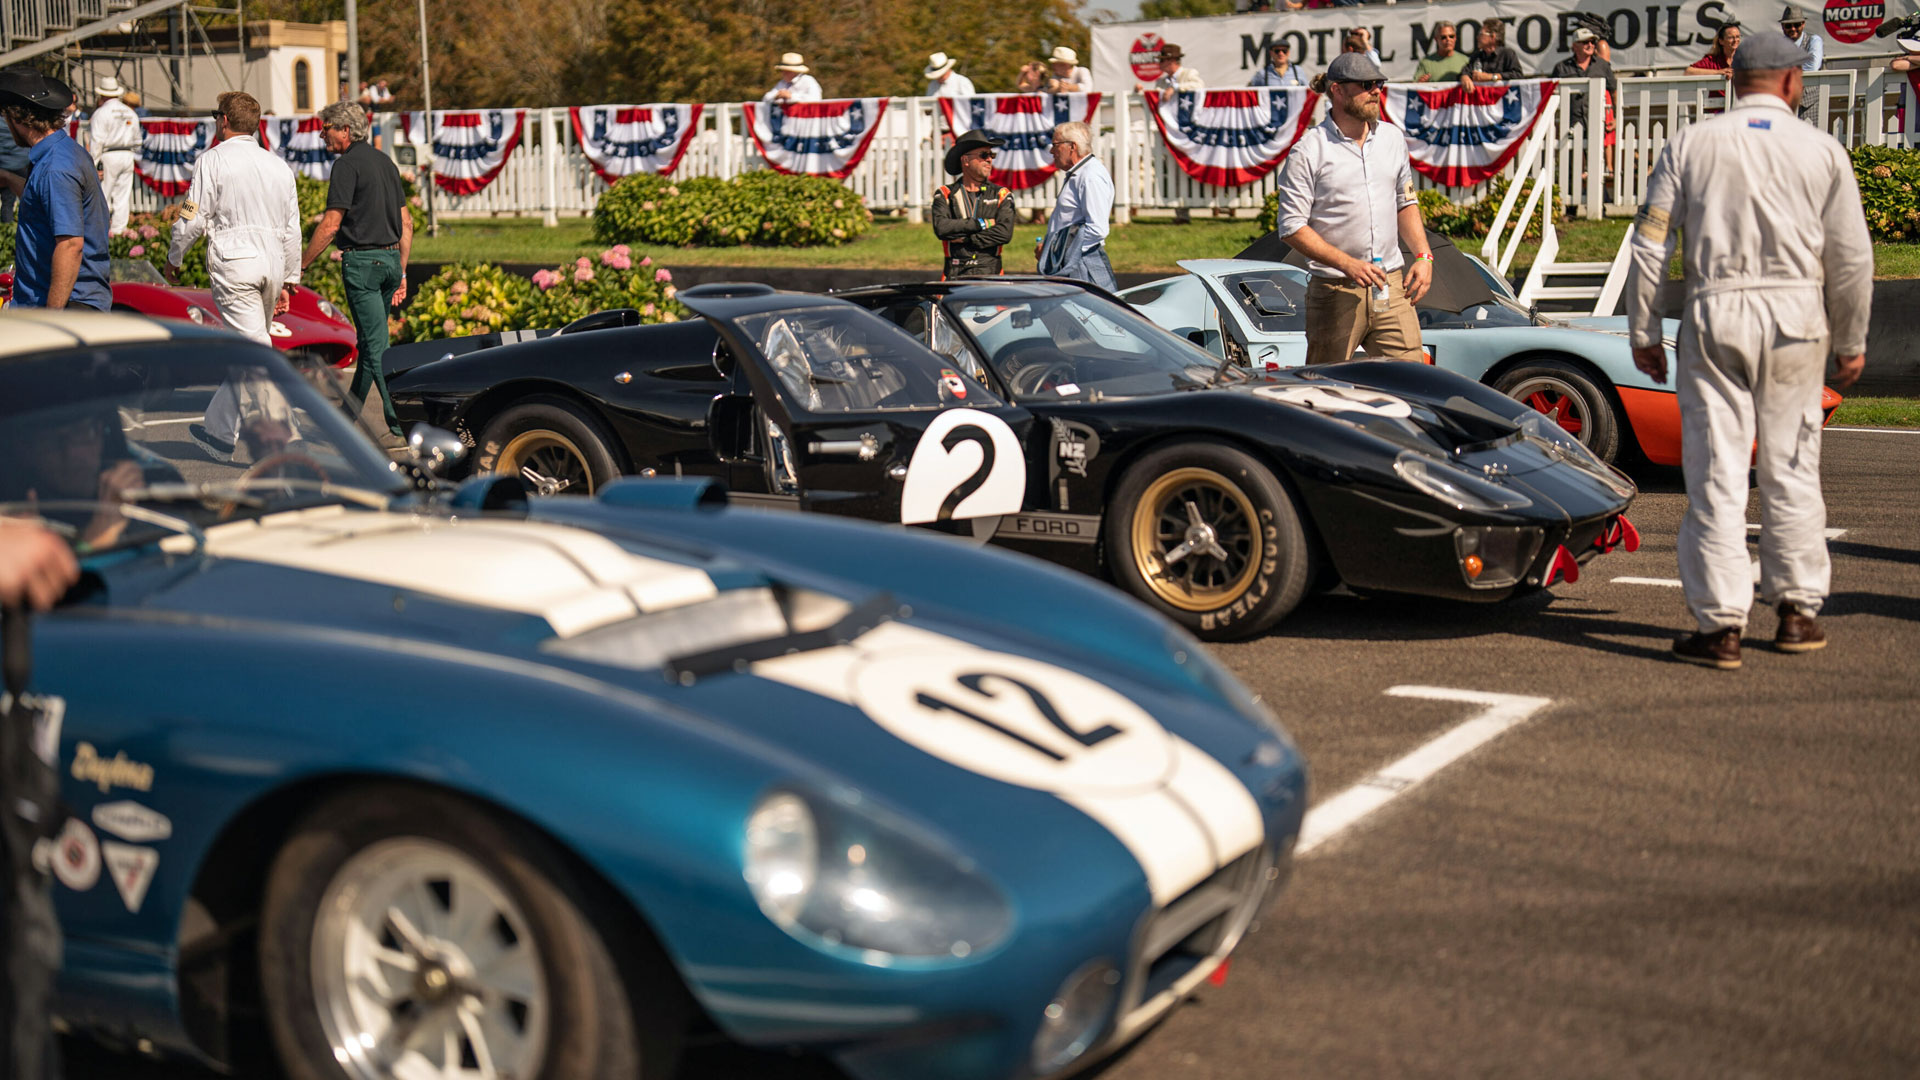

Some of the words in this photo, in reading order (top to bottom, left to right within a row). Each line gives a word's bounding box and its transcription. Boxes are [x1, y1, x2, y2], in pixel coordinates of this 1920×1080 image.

[1606, 1, 1724, 50] OILS
[1826, 5, 1882, 21] MOTUL
[1060, 442, 1085, 458] NZ
[937, 424, 995, 521] 2
[1016, 518, 1080, 535] FORD
[916, 672, 1124, 761] 12
